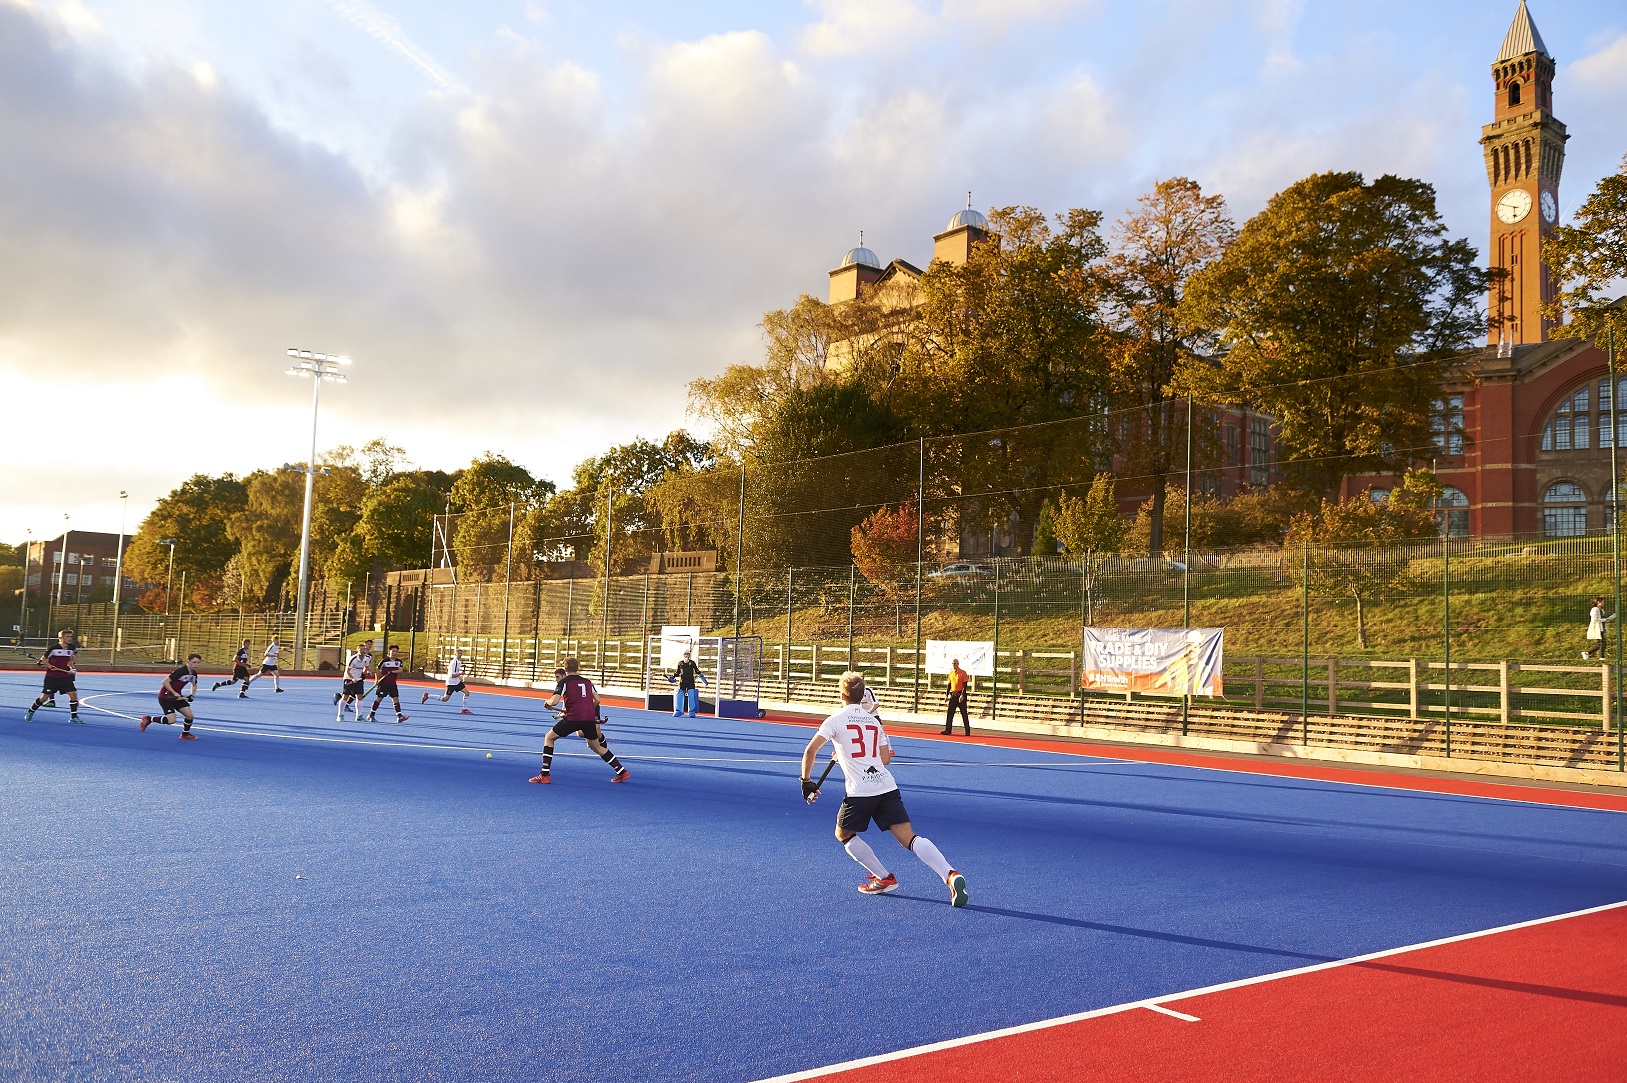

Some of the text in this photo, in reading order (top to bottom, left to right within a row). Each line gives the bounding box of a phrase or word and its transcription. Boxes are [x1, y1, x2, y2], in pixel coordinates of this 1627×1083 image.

[1089, 642, 1169, 656] TRADE & DIY
[1099, 655, 1157, 669] SUPPLIES
[578, 683, 586, 697] 7
[846, 724, 878, 758] 37
